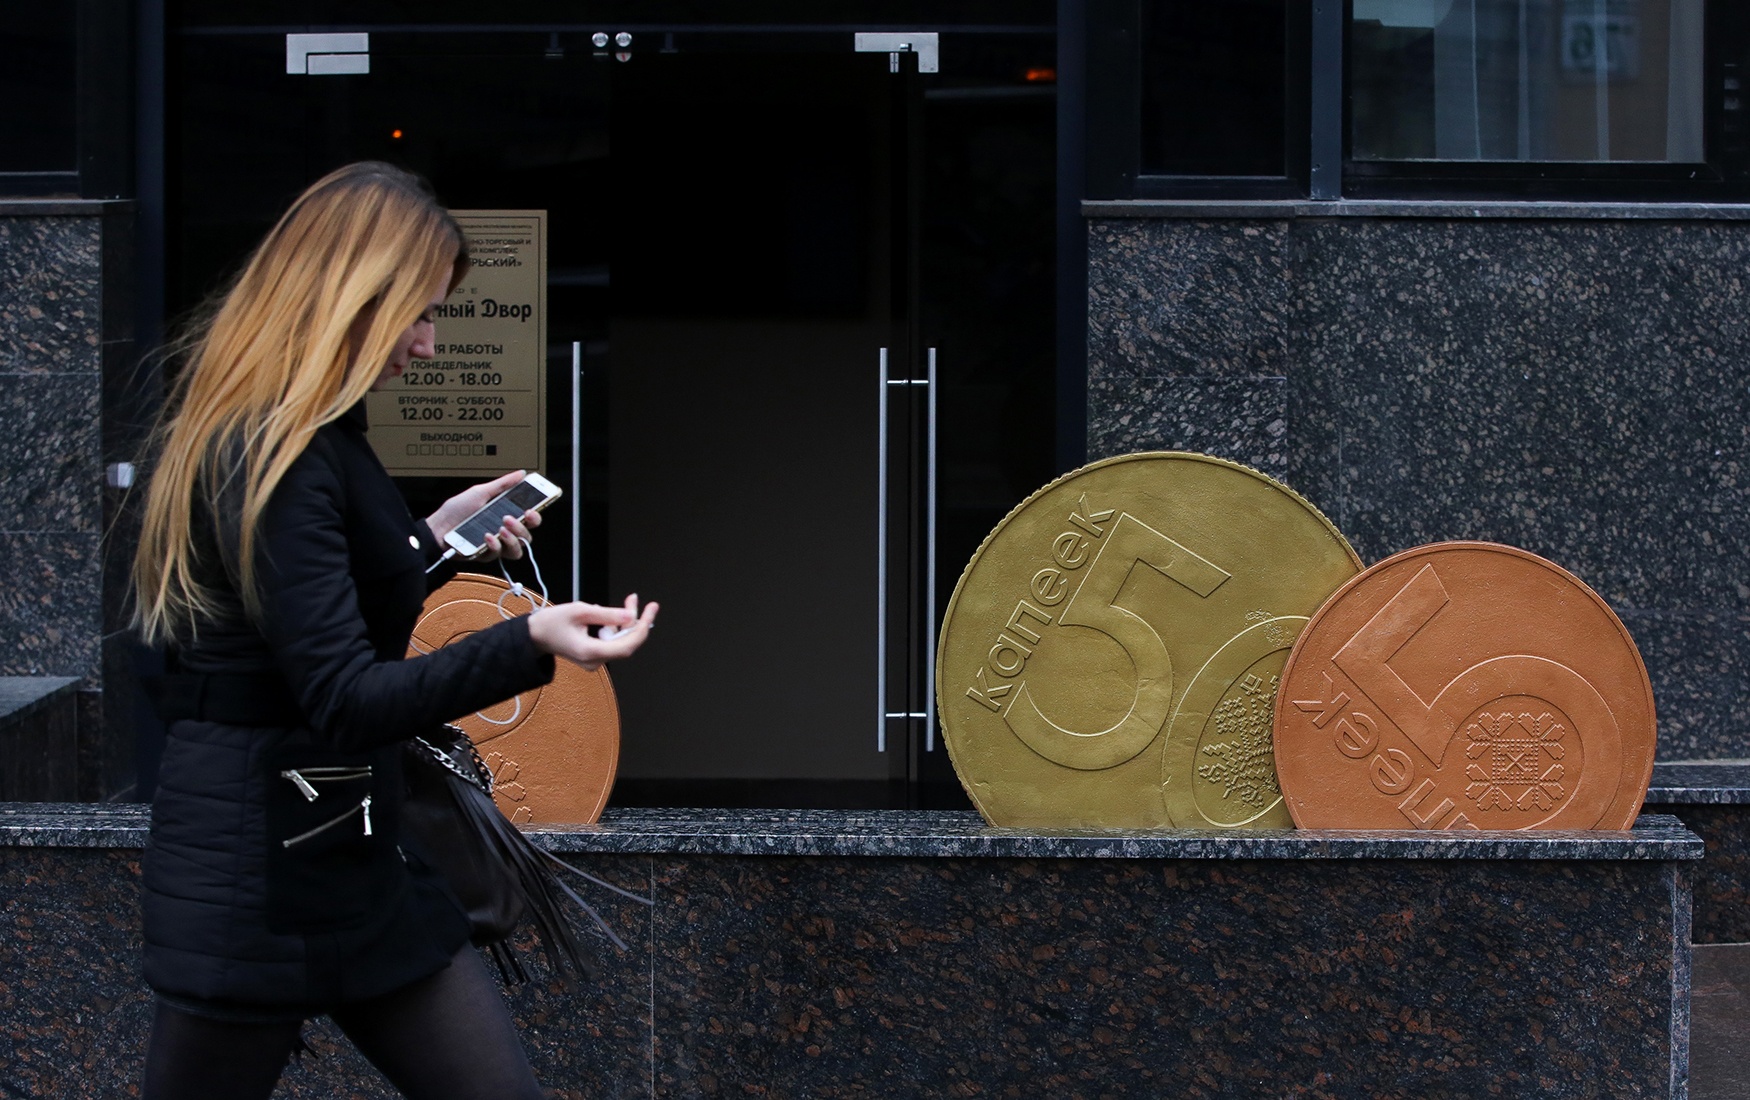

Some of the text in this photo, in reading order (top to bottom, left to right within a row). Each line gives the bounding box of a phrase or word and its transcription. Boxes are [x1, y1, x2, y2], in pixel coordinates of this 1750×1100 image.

[480, 298, 532, 322] Двор
[449, 344, 503, 354] РАБОТЫ
[411, 361, 492, 370] ПОНЕДЕЛЬНИК
[402, 373, 445, 385] 12.00
[459, 373, 502, 385] 18.00
[398, 396, 448, 405] ВТОРНИК
[456, 396, 505, 405] СУББОТА
[400, 408, 444, 421] 12.00
[457, 408, 504, 421] 22.00
[420, 432, 483, 442] ВЫХОДНОЙ
[965, 492, 1116, 712] капеек
[1003, 511, 1232, 771] 5
[1331, 562, 1623, 829] 5
[1292, 670, 1476, 830] пеек
